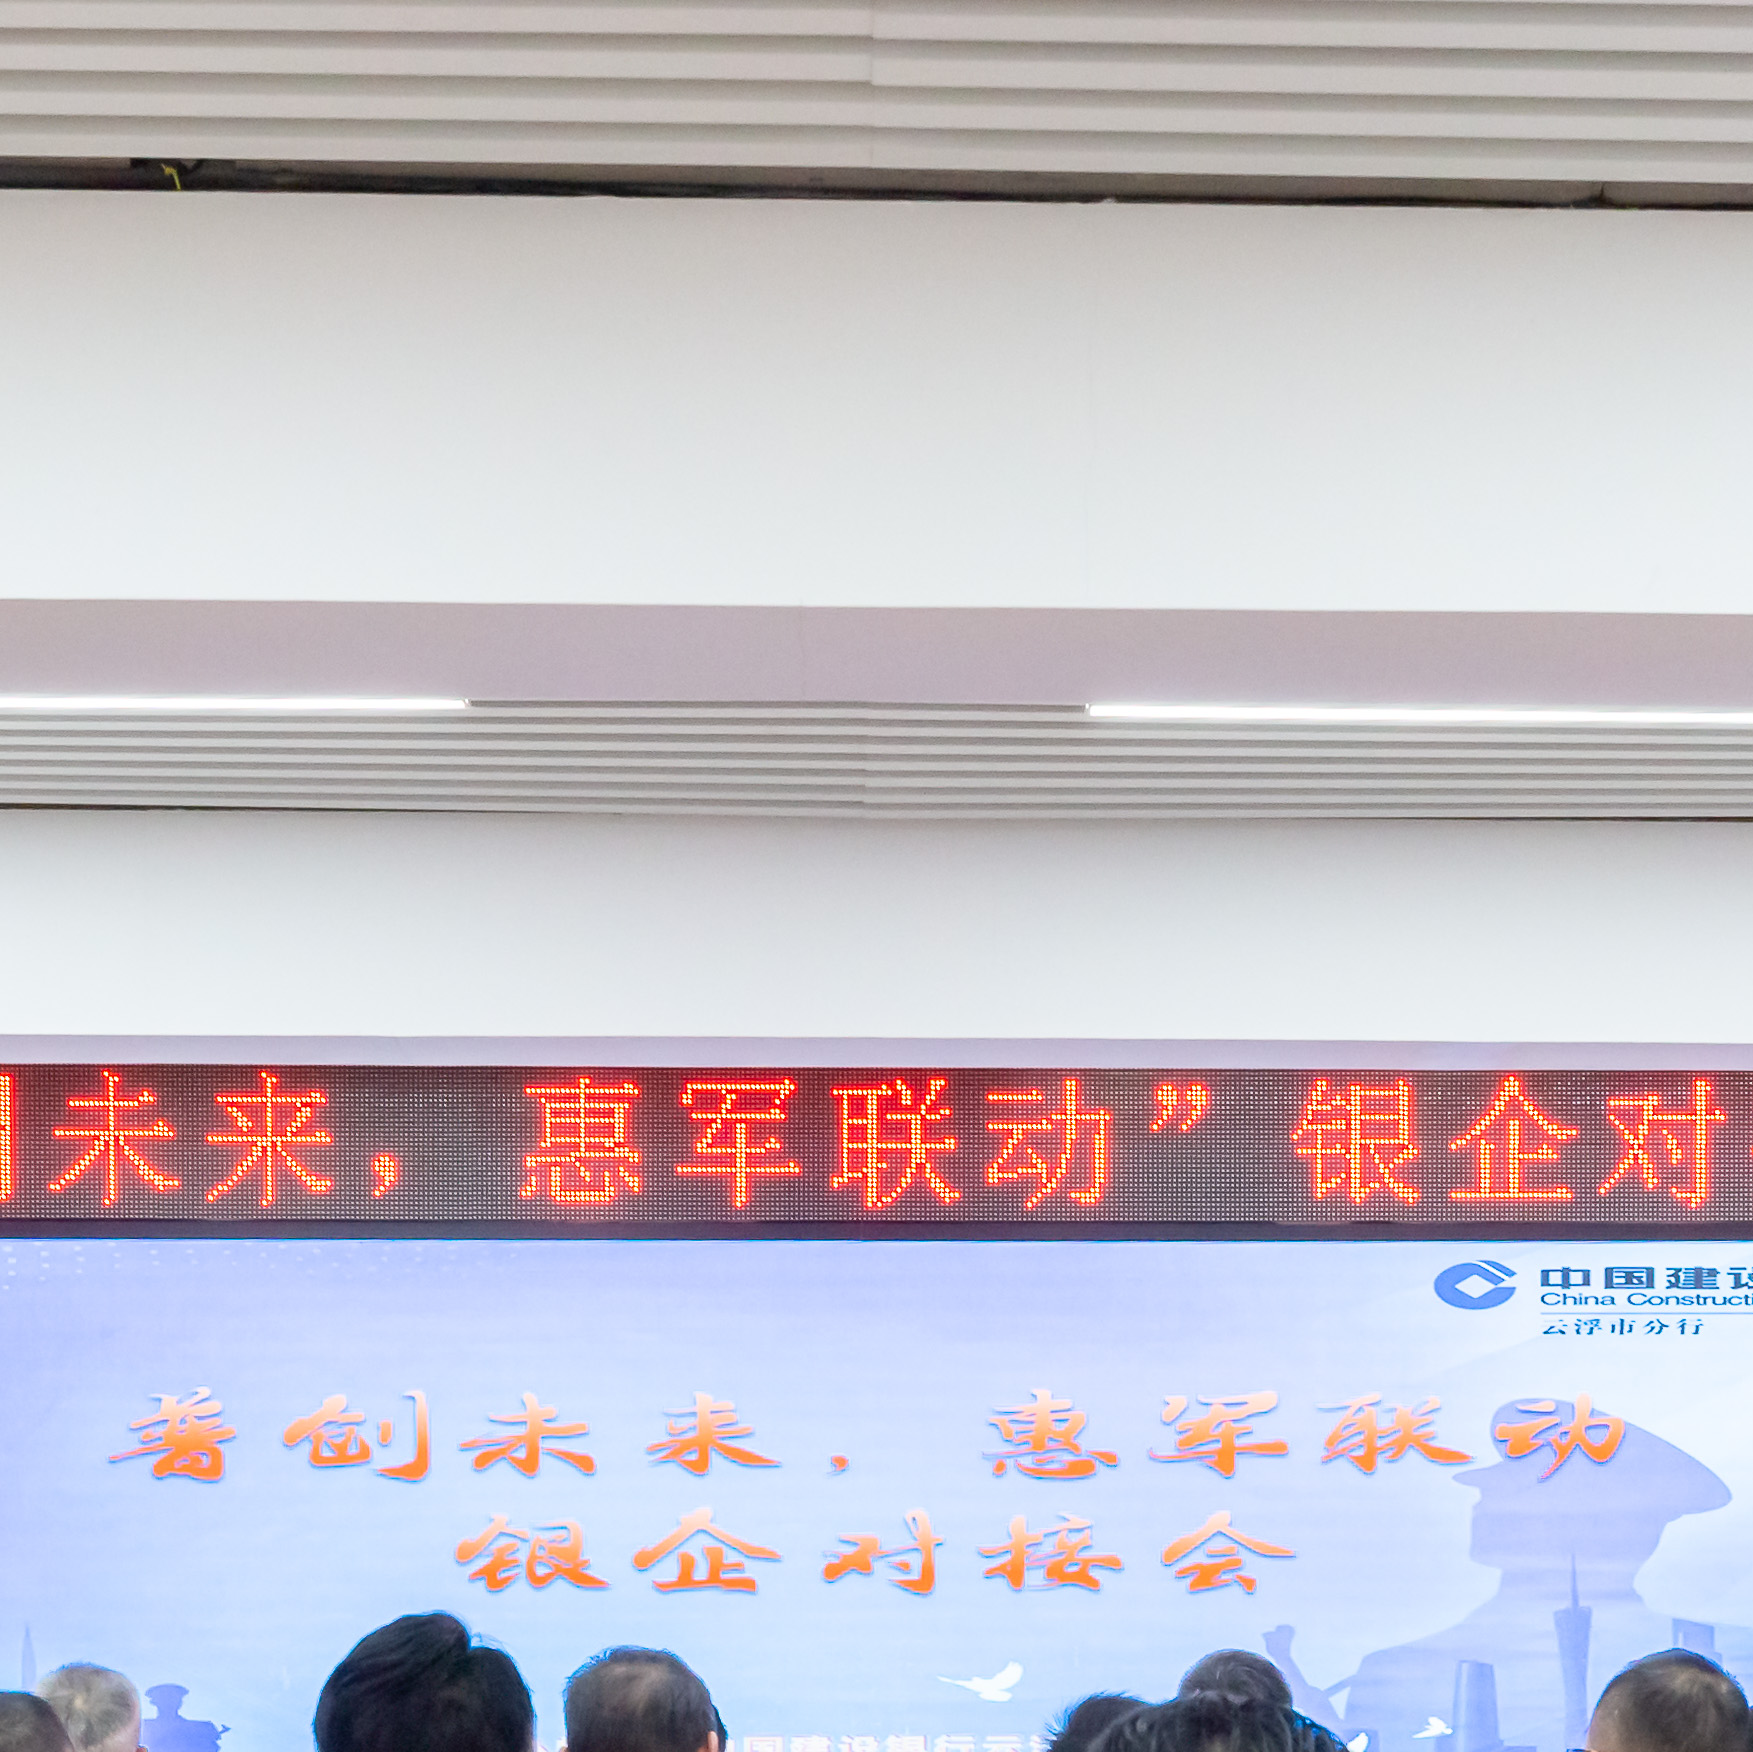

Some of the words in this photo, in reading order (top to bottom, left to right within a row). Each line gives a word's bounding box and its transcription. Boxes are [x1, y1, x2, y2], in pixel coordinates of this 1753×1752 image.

[1539, 1292, 1617, 1308] China
[1540, 1317, 1706, 1336] 云浮市分行
[454, 1506, 1297, 1595] 银企对接会
